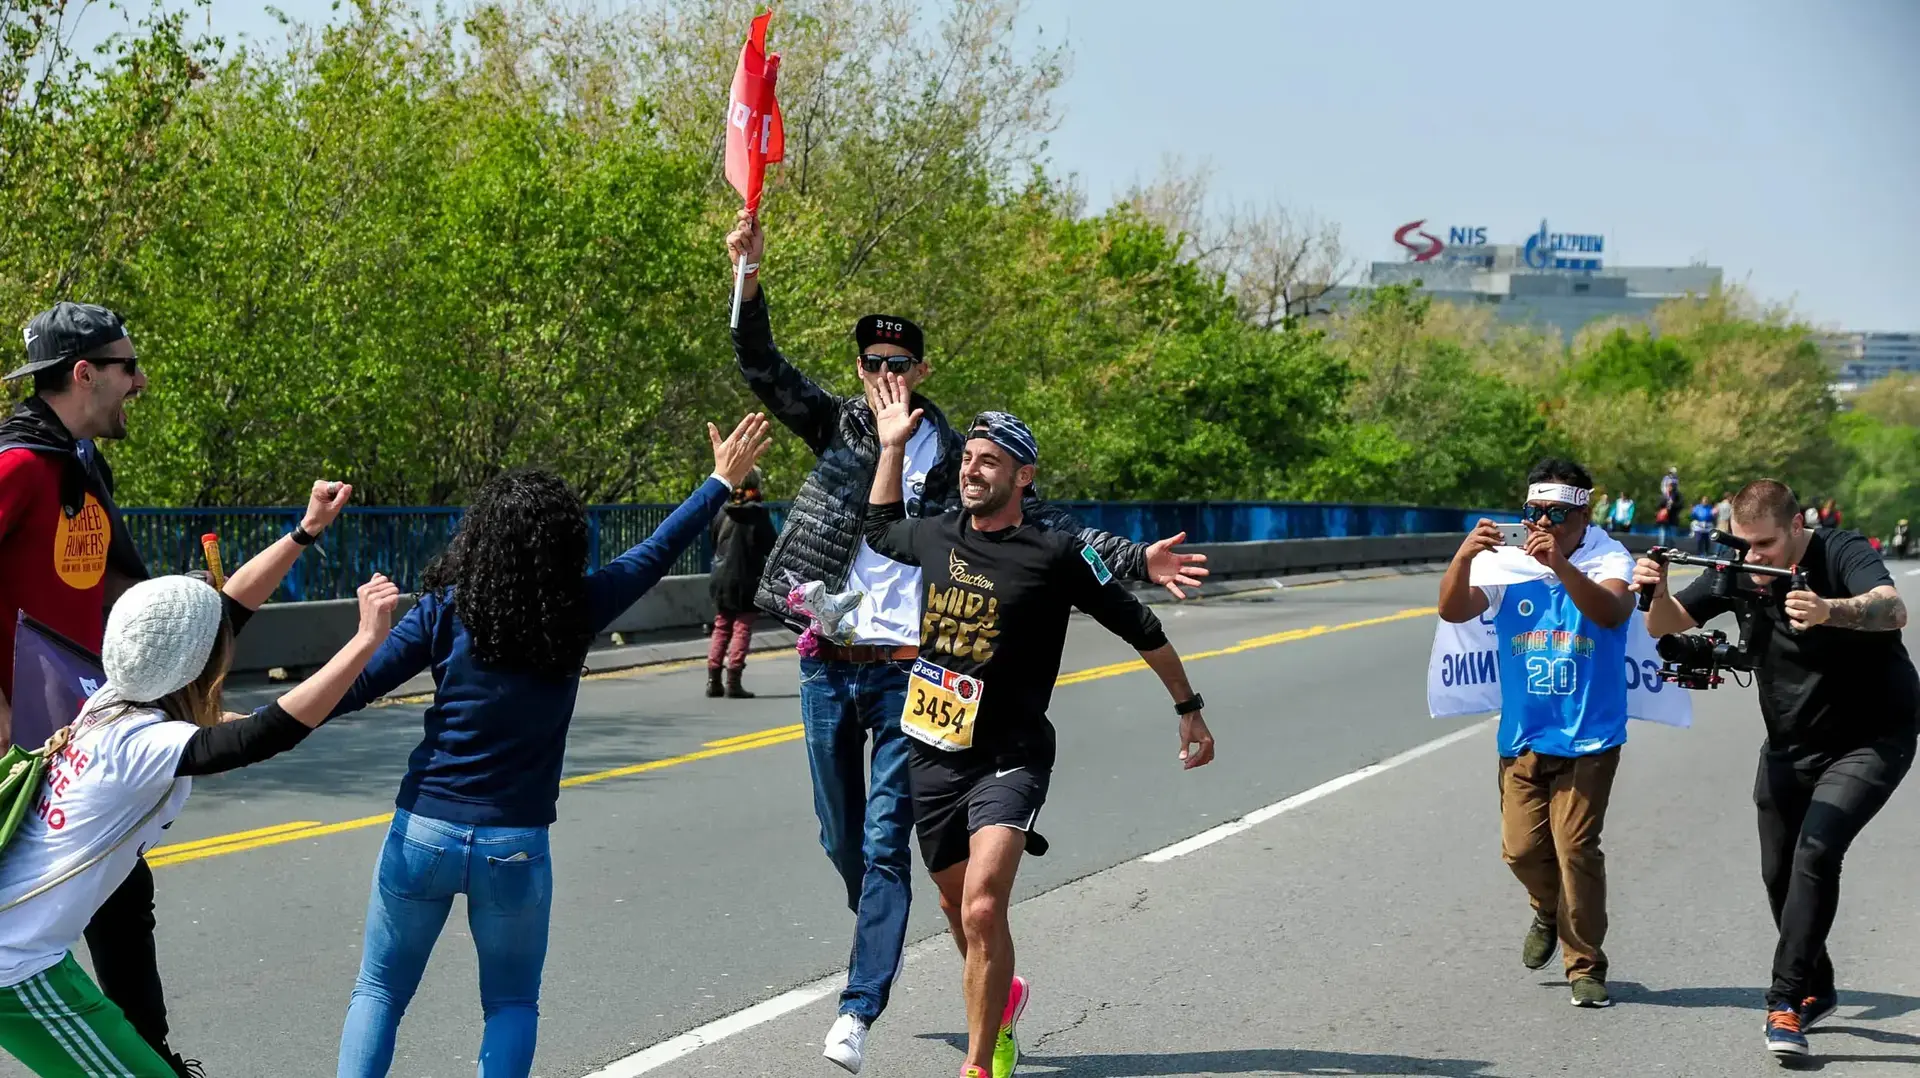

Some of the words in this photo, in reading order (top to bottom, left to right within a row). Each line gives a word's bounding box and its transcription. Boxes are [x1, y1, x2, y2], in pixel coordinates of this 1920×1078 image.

[1449, 226, 1488, 245] NIS
[876, 319, 903, 332] BTG
[949, 564, 994, 591] Reaction
[920, 611, 1000, 663] FREE
[1551, 630, 1572, 653] THE
[1526, 656, 1577, 695] 20
[912, 688, 966, 734] 3454
